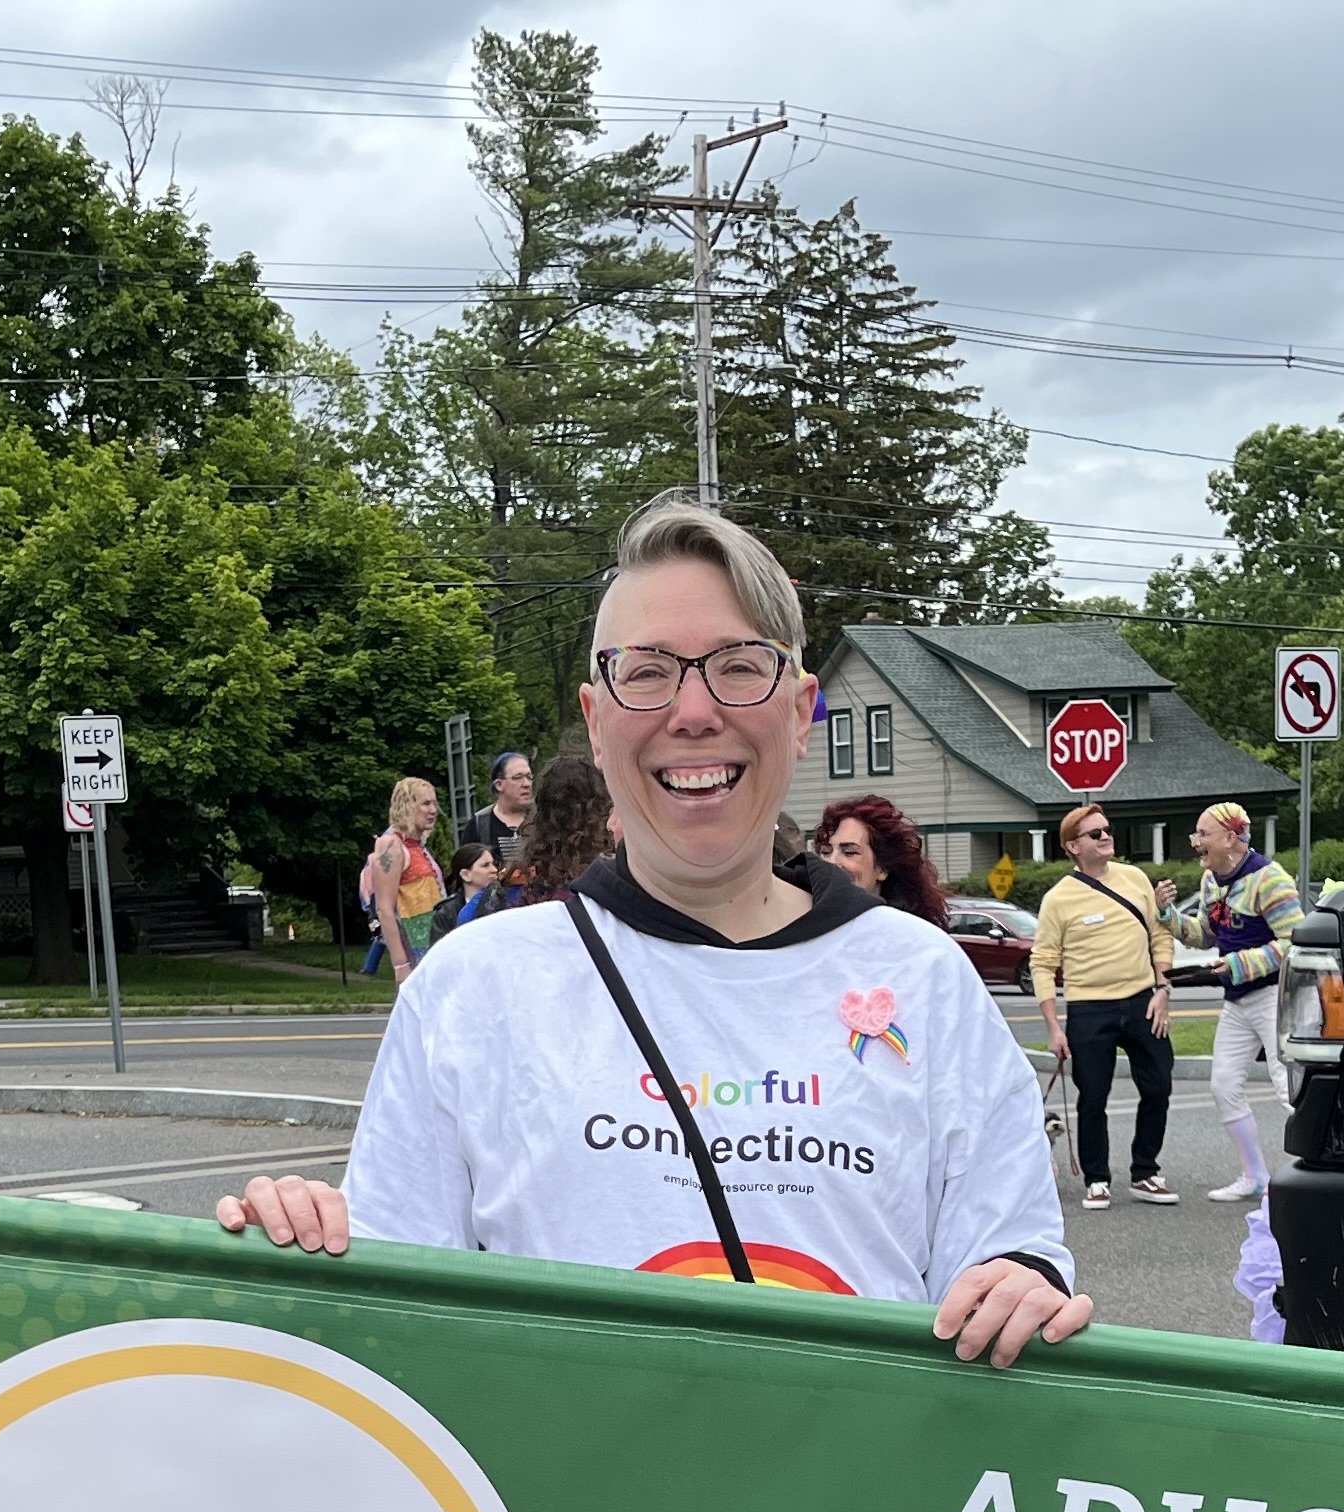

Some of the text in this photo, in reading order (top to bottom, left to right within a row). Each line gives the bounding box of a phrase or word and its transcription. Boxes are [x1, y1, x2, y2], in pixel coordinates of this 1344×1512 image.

[71, 729, 114, 745] KEEP
[1053, 728, 1121, 764] STOP
[71, 774, 122, 790] RIGHT
[584, 1114, 875, 1174] Conections
[663, 1174, 815, 1195] employ resource group
